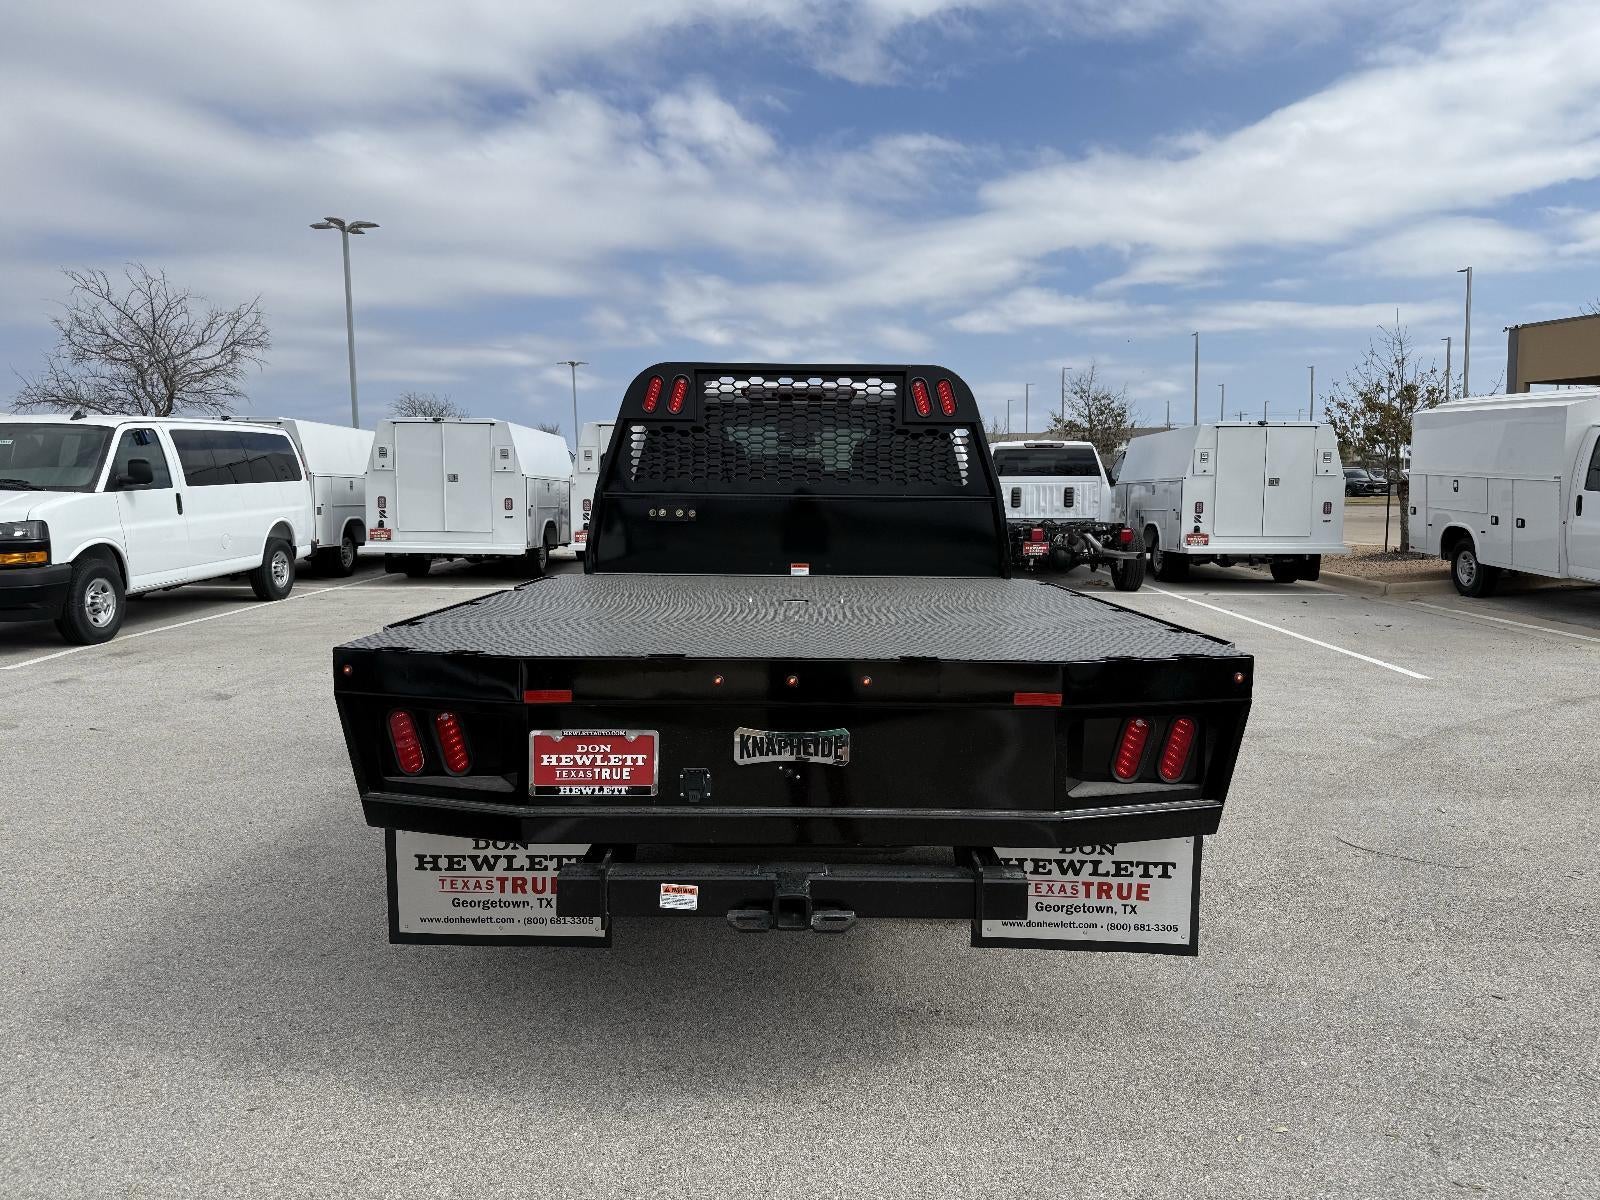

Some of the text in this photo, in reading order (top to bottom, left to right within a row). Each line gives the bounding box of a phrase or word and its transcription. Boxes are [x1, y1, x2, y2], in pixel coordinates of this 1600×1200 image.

[576, 744, 612, 753] DON
[739, 733, 845, 761] KNAPHEIDE
[540, 754, 647, 766] HEWLETT
[558, 786, 629, 795] HEWLETT
[471, 838, 529, 851] DON
[1059, 843, 1117, 856] DON
[1028, 882, 1079, 896] EXAS
[451, 897, 554, 911] Georgetown, TX
[1034, 901, 1138, 916] Georgetown, TX
[419, 915, 594, 926] www.donhewlett.com (800) 681-3305
[1001, 919, 1179, 933] www.donhewlett.com (800) 681-3305
